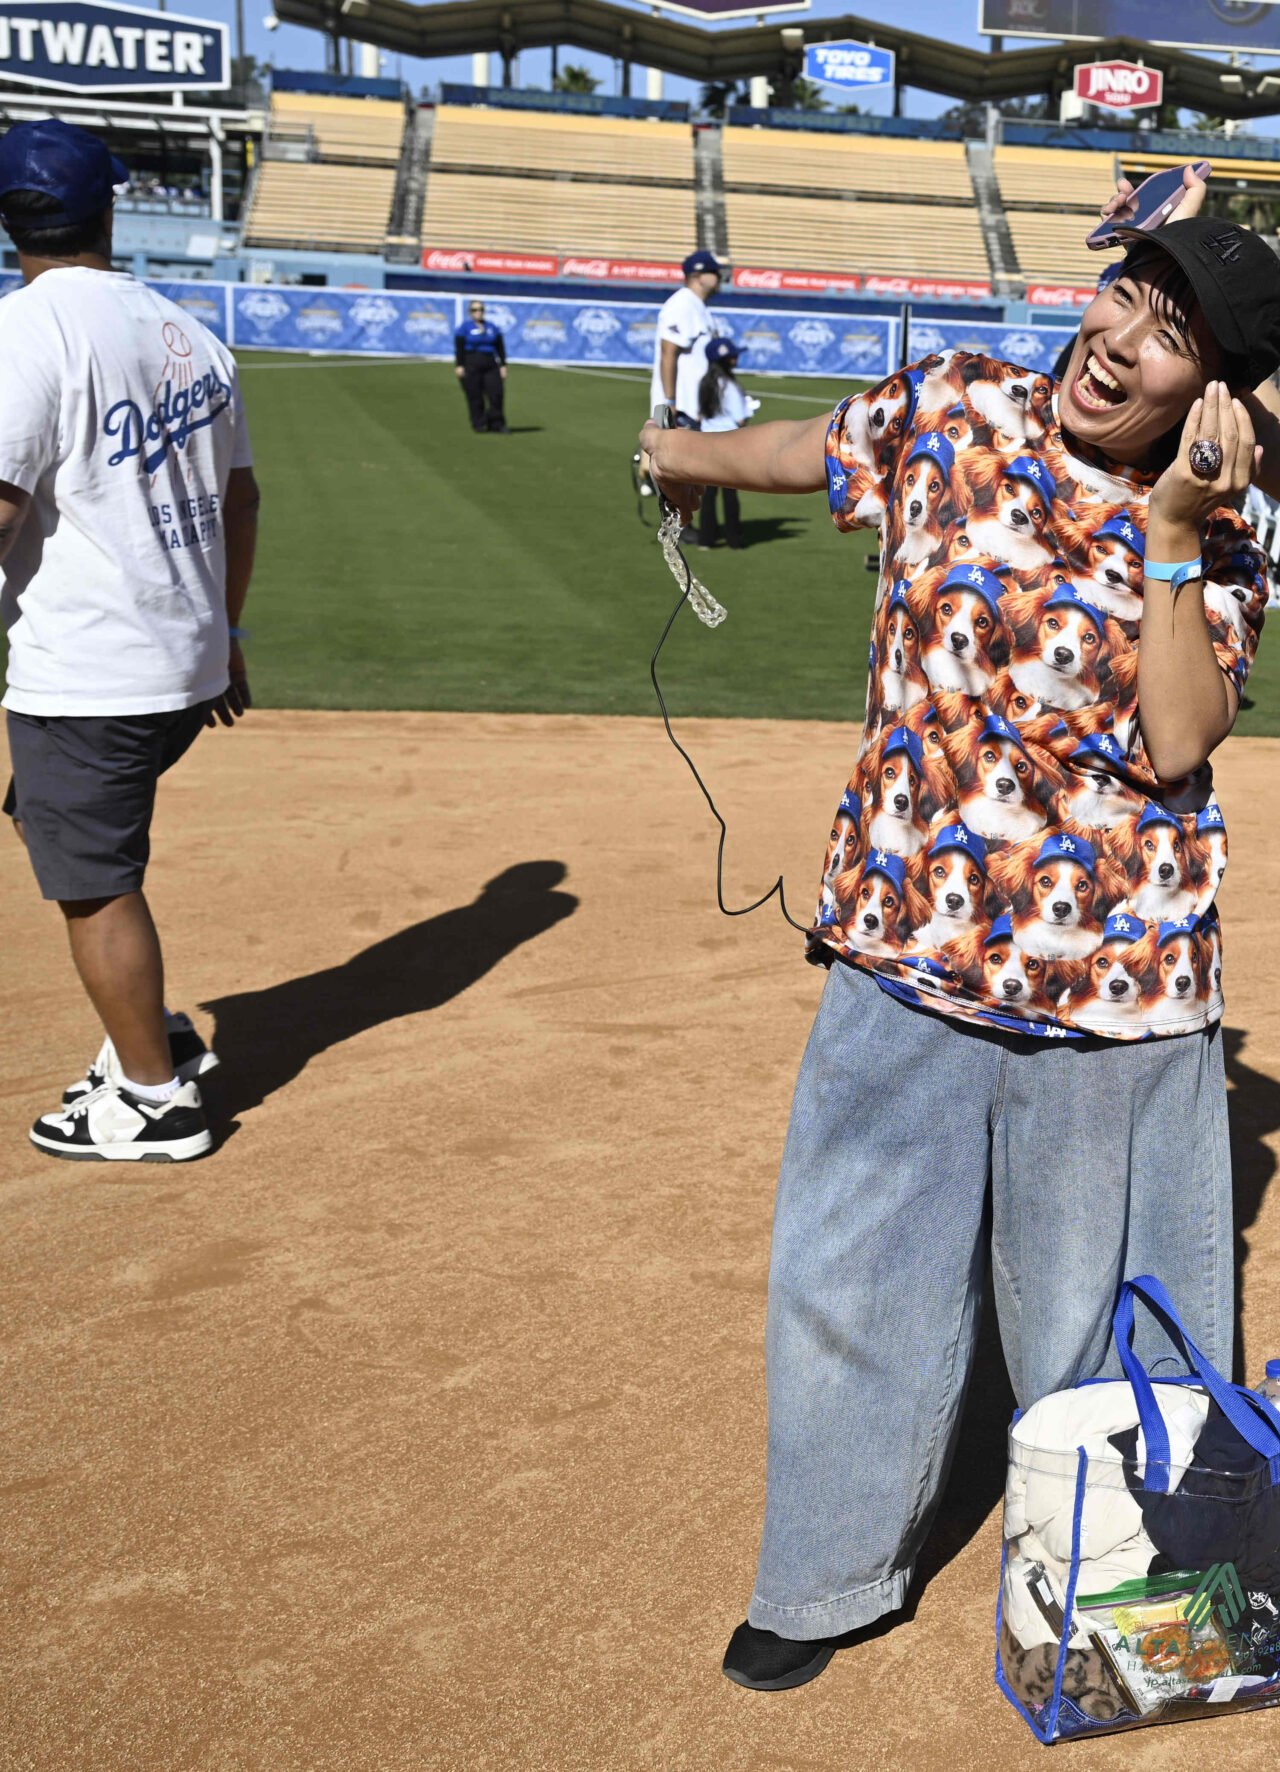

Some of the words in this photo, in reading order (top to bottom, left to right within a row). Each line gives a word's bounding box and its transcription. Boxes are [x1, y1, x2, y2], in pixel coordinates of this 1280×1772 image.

[815, 48, 871, 66] TOYO
[824, 64, 885, 82] TIRES
[1088, 67, 1149, 96] JINRO
[103, 365, 232, 474] Dodgers
[927, 432, 940, 452] LA
[1028, 460, 1041, 479] LA
[1120, 521, 1134, 541] LA
[968, 567, 985, 586] LA
[1098, 733, 1112, 753] LA
[1206, 805, 1221, 823] LA
[955, 825, 968, 844] LA
[1060, 835, 1076, 853] LA
[1113, 916, 1130, 933] LA
